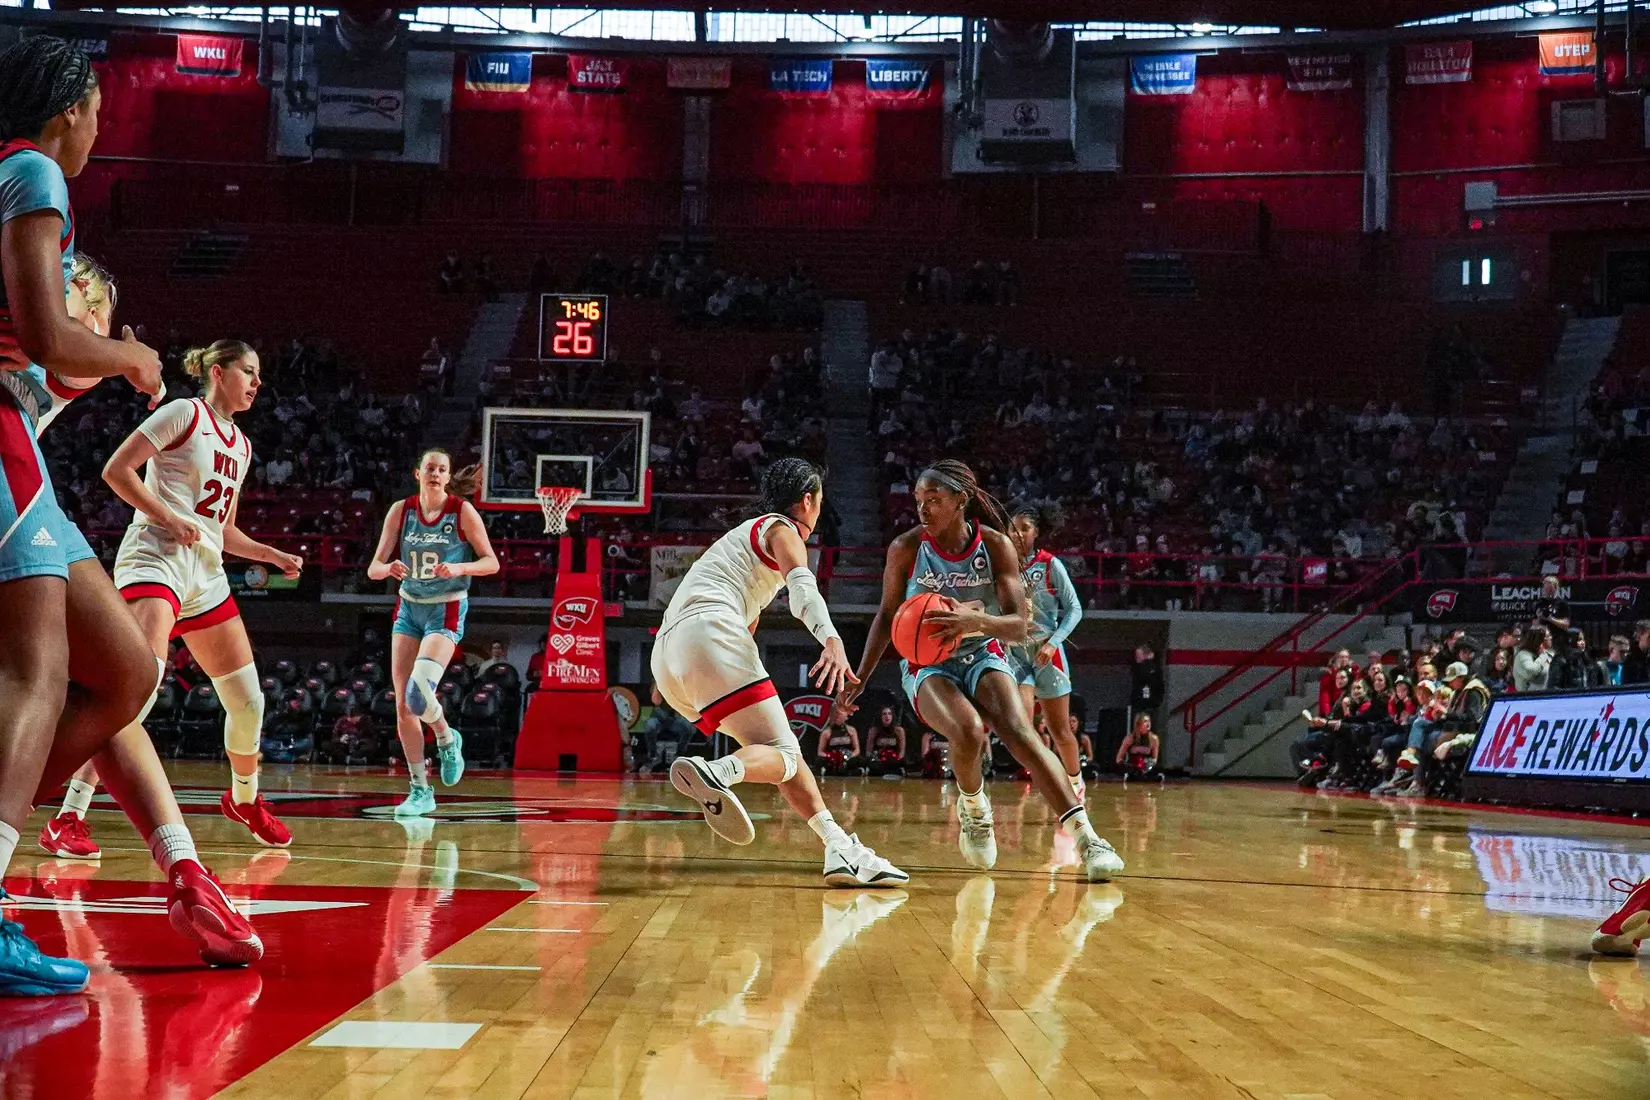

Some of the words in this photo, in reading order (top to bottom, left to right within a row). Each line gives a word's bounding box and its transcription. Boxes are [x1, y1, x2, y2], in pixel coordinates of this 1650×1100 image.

[193, 46, 226, 60] WKU
[1555, 43, 1591, 58] UTEP
[487, 61, 510, 75] FIU
[870, 69, 928, 82] LIBERTY
[577, 72, 621, 84] STATE
[771, 70, 789, 82] LA
[792, 69, 828, 83] TECH
[561, 301, 600, 320] 7:46
[553, 321, 592, 354] 26
[213, 449, 238, 481] WKU
[194, 478, 234, 524] 23
[409, 550, 439, 580] 18
[916, 570, 946, 593] Lady
[1491, 585, 1572, 601] LEACHAN
[565, 603, 587, 614] WKU
[1500, 601, 1526, 611] BUICK
[575, 634, 600, 643] Graves
[575, 642, 600, 650] Gilbert
[793, 703, 822, 718] WKU
[1476, 704, 1537, 769] ACE
[1523, 717, 1650, 773] REWARDS
